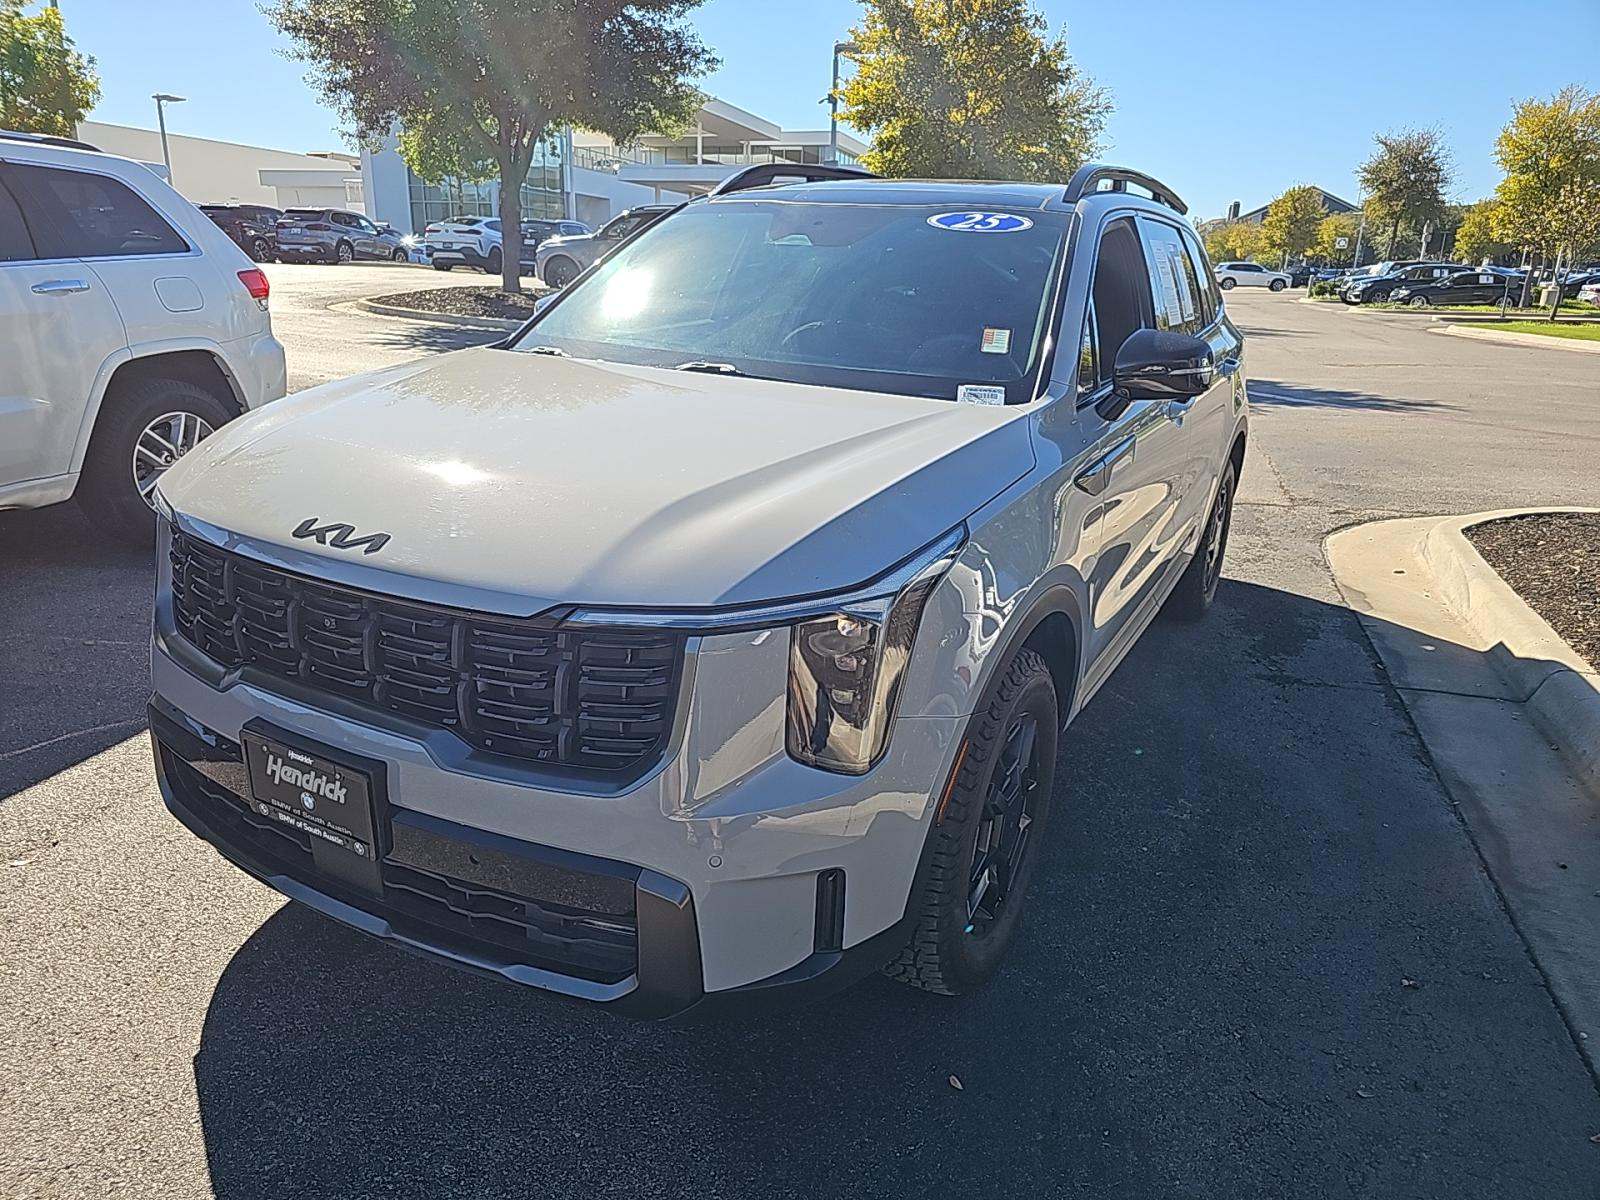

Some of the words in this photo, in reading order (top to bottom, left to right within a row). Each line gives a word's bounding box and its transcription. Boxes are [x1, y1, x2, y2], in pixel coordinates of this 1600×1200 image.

[950, 213, 1010, 229] 25
[266, 754, 347, 804] Hendrick
[278, 812, 295, 825] BMW
[296, 820, 303, 828] of
[303, 822, 322, 836] South
[322, 831, 344, 846] Austin
[302, 811, 326, 825] South
[326, 821, 352, 836] Austin
